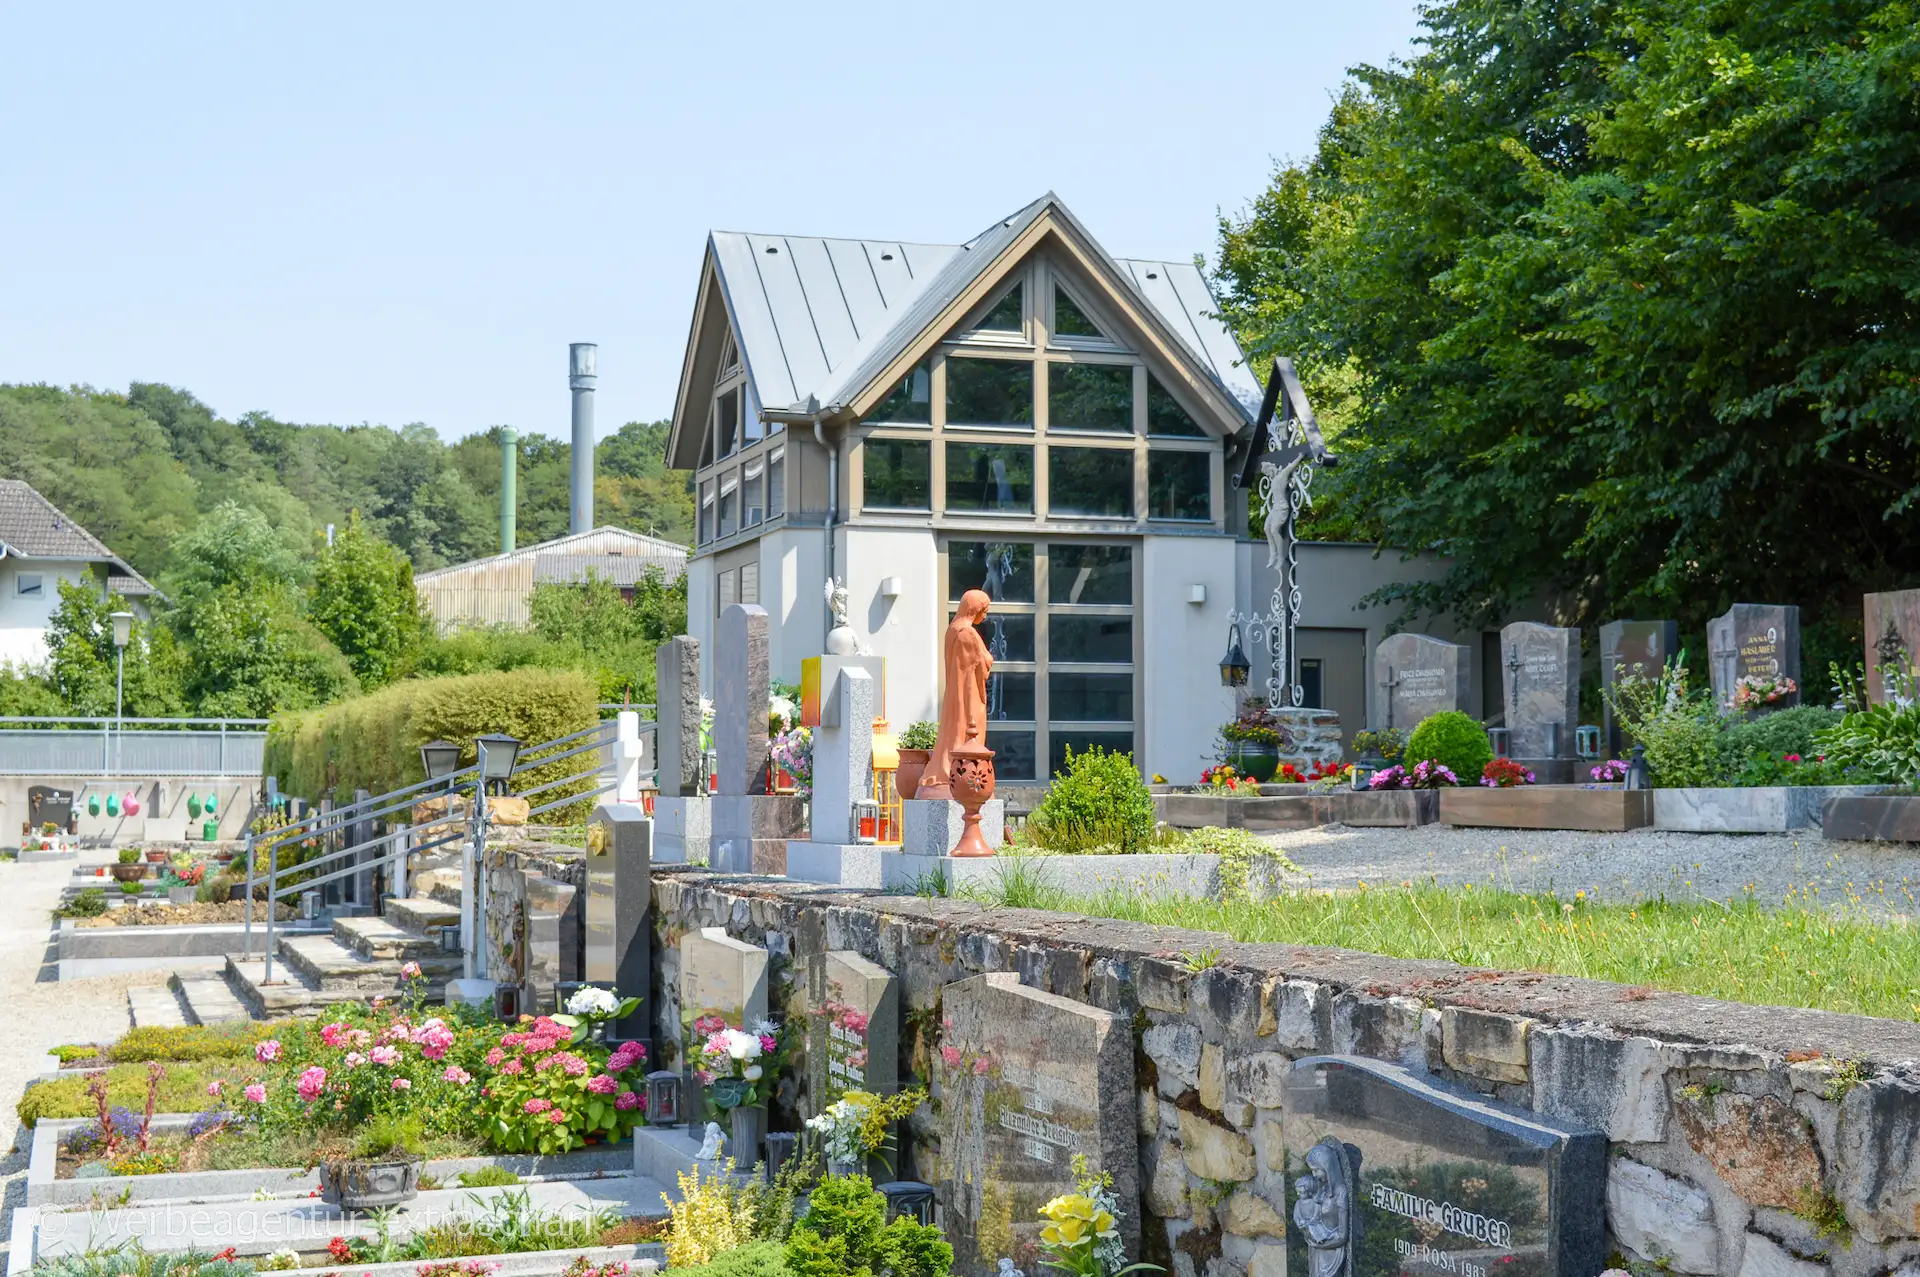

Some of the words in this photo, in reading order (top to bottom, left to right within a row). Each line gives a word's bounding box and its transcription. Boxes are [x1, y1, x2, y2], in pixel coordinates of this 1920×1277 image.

[1371, 1183, 1436, 1224] FAMILIE
[1440, 1201, 1511, 1249] GRUBER
[1394, 1238, 1417, 1259] 1909
[1422, 1245, 1456, 1273] ROSA
